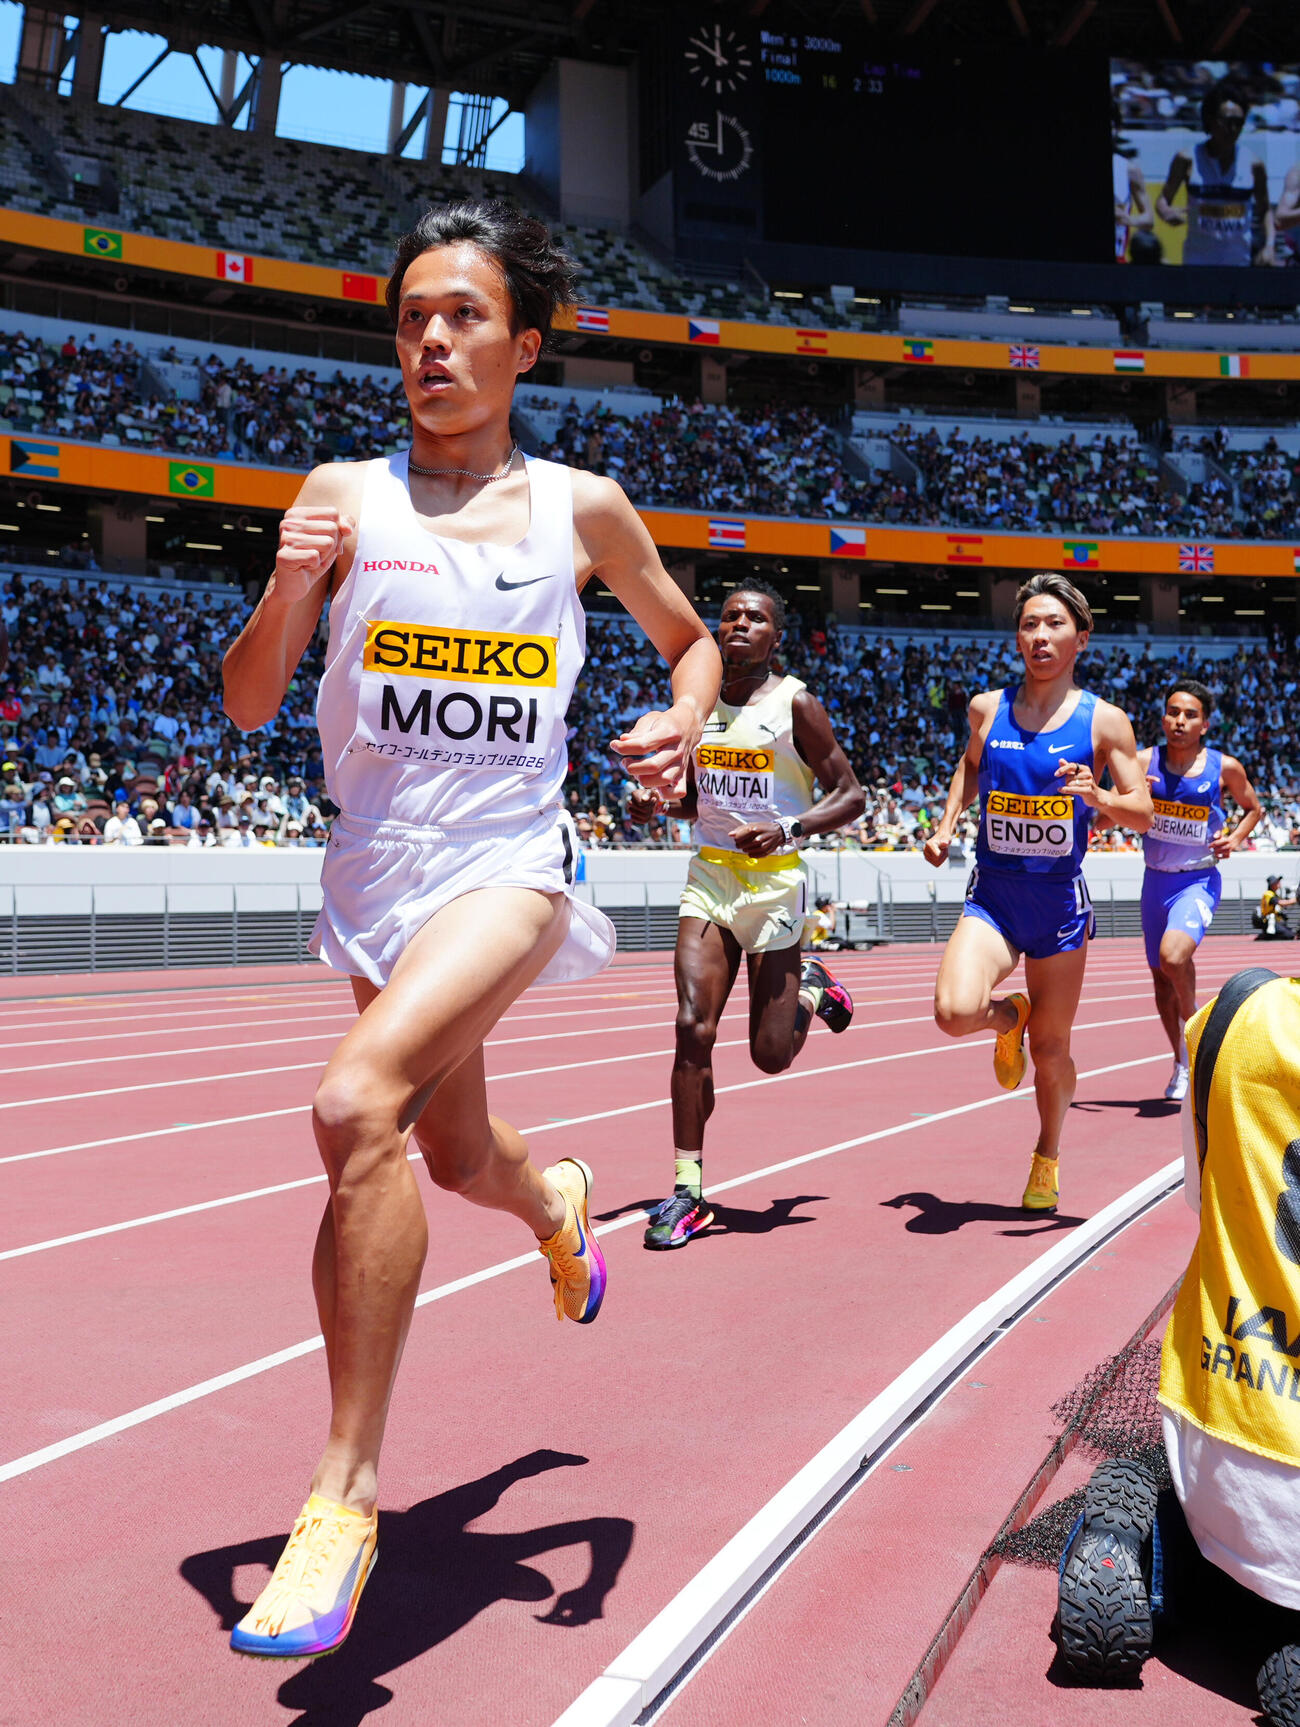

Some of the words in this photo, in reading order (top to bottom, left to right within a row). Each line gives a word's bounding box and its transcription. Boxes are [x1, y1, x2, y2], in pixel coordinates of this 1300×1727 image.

[760, 48, 798, 66] Final
[765, 67, 802, 85] 1000m
[688, 122, 709, 141] 45
[363, 560, 440, 575] HONDA
[374, 629, 550, 679] SEIKO
[381, 685, 537, 744] MORI
[699, 748, 769, 770] SEIKO
[698, 773, 768, 799] KIMUTAI
[990, 794, 1068, 817] SEIKO
[1153, 800, 1206, 820] SEIKO
[991, 819, 1067, 845] ENDO
